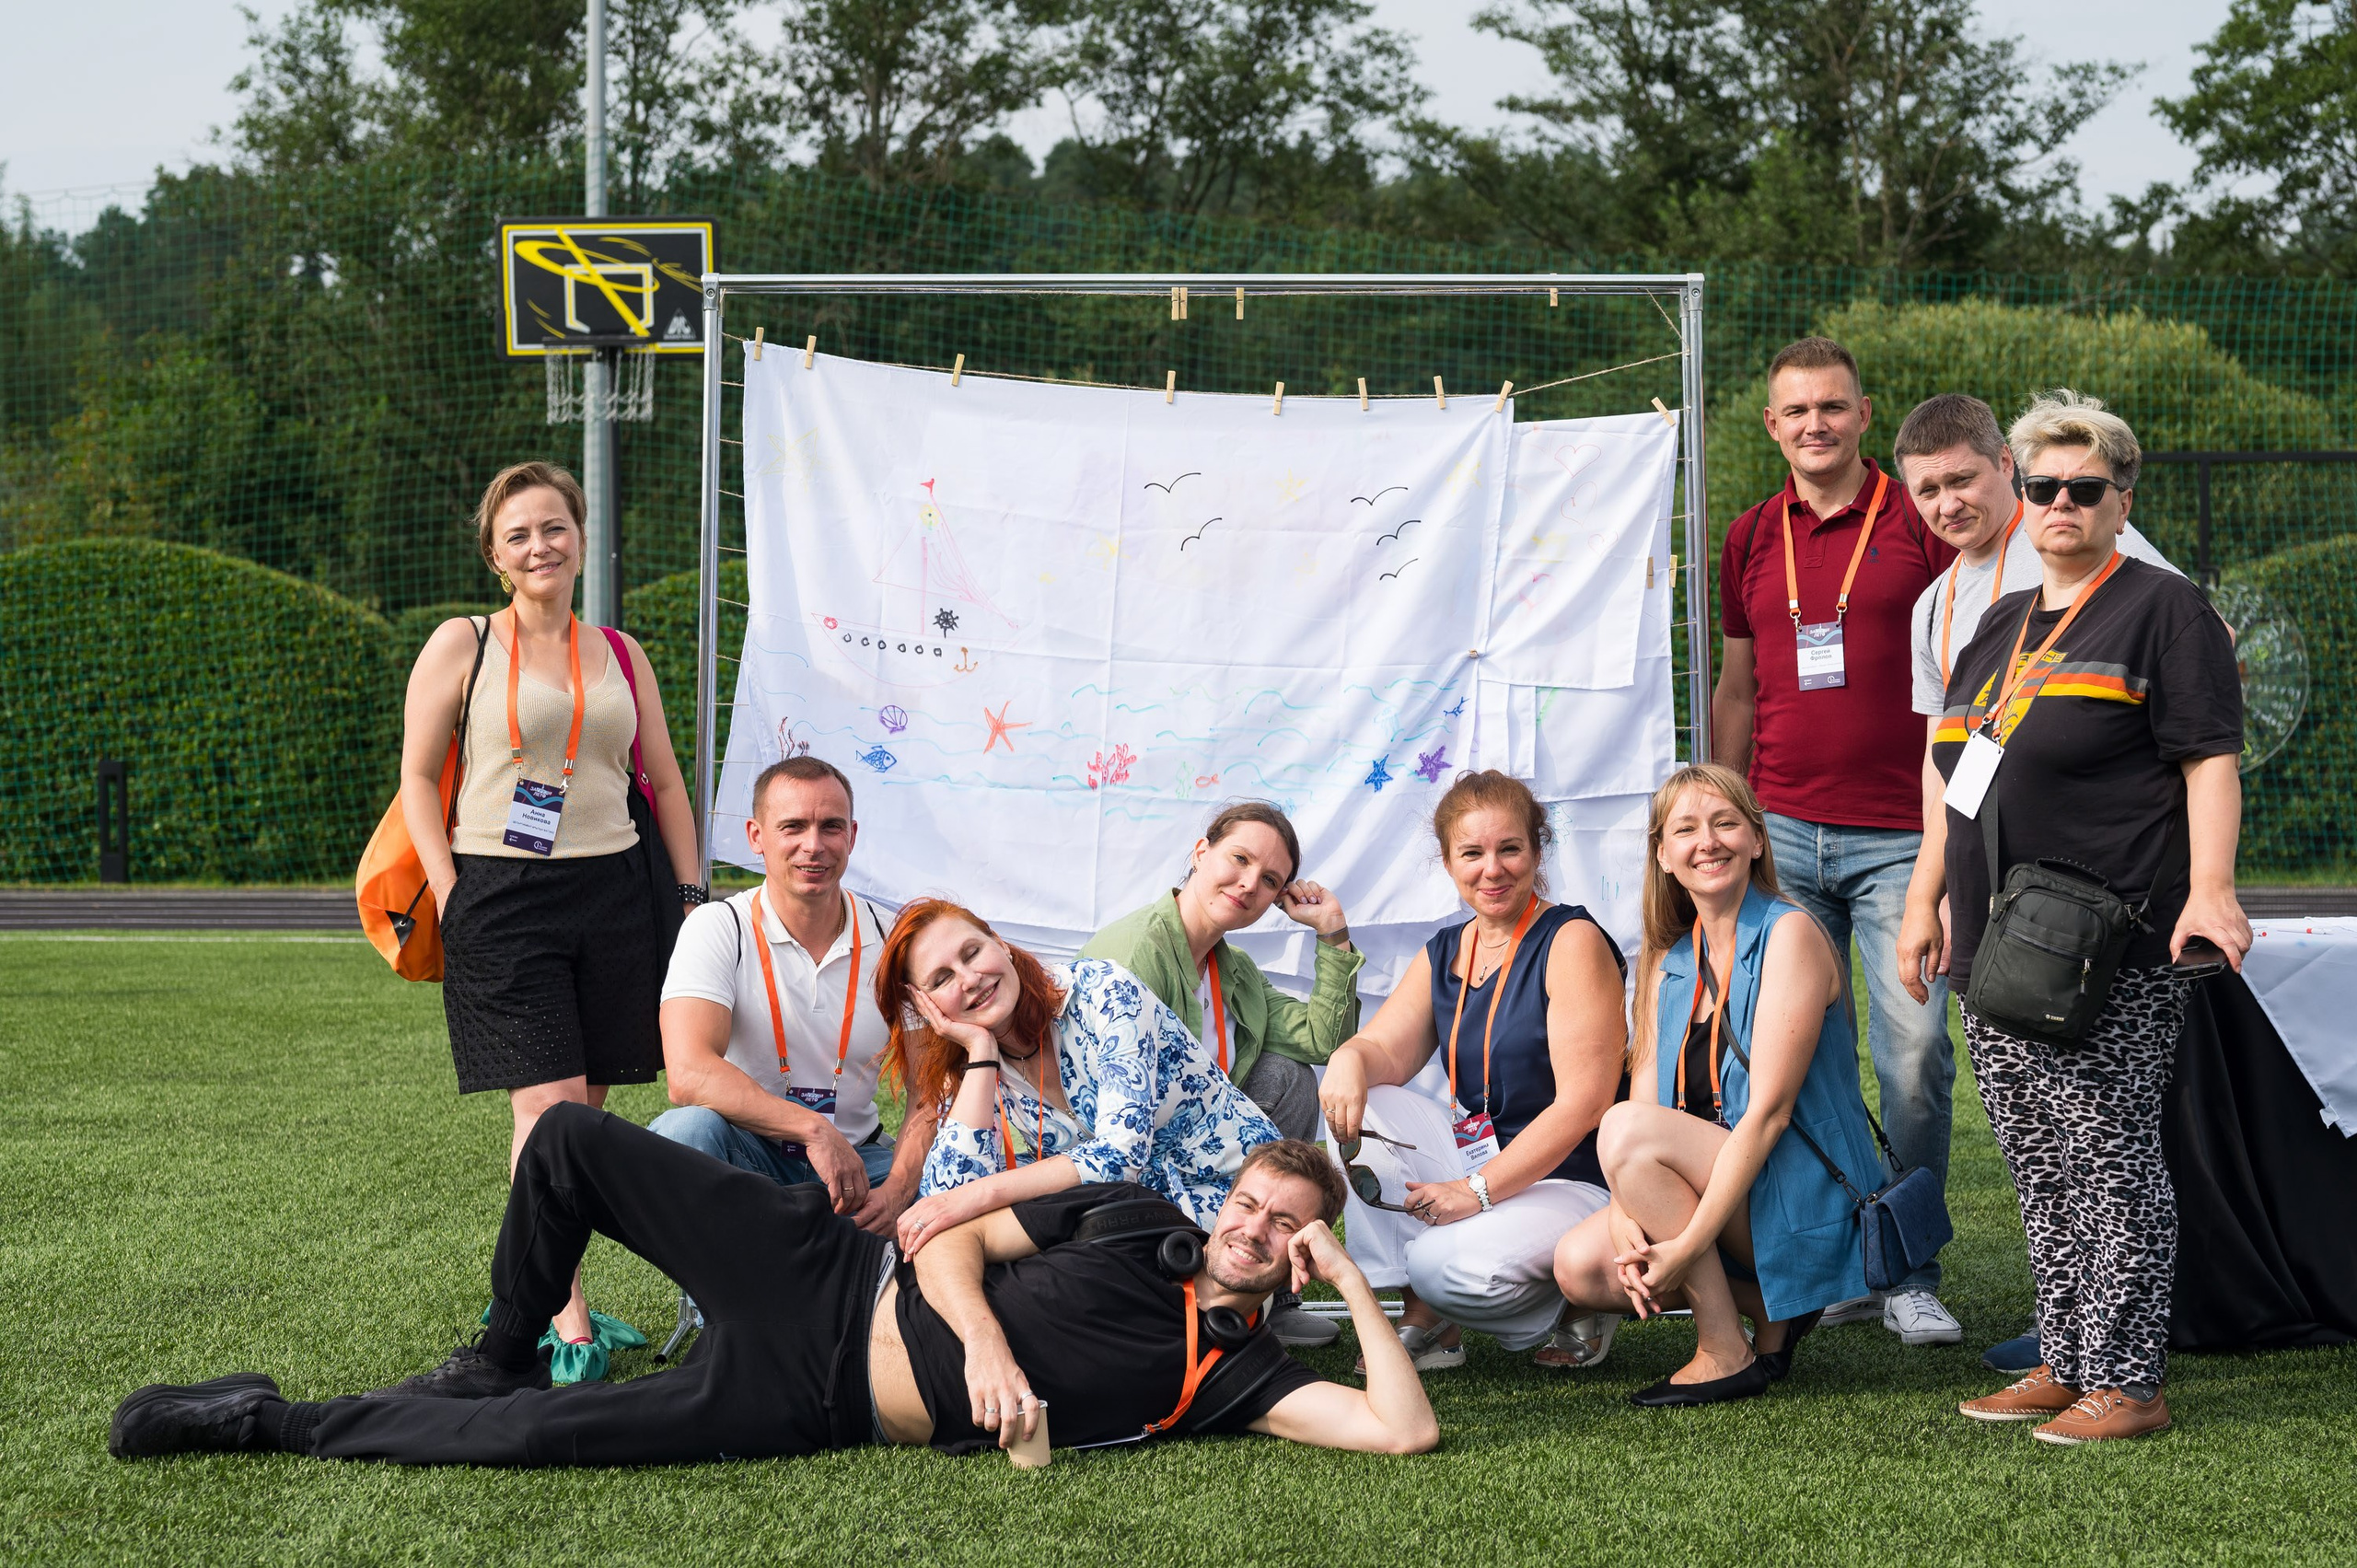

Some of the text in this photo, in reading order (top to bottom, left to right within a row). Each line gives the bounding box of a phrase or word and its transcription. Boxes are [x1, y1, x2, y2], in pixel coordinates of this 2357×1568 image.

[522, 813, 551, 825] Новикова
[530, 809, 545, 818] Анна
[1466, 1143, 1489, 1156] Екатерина
